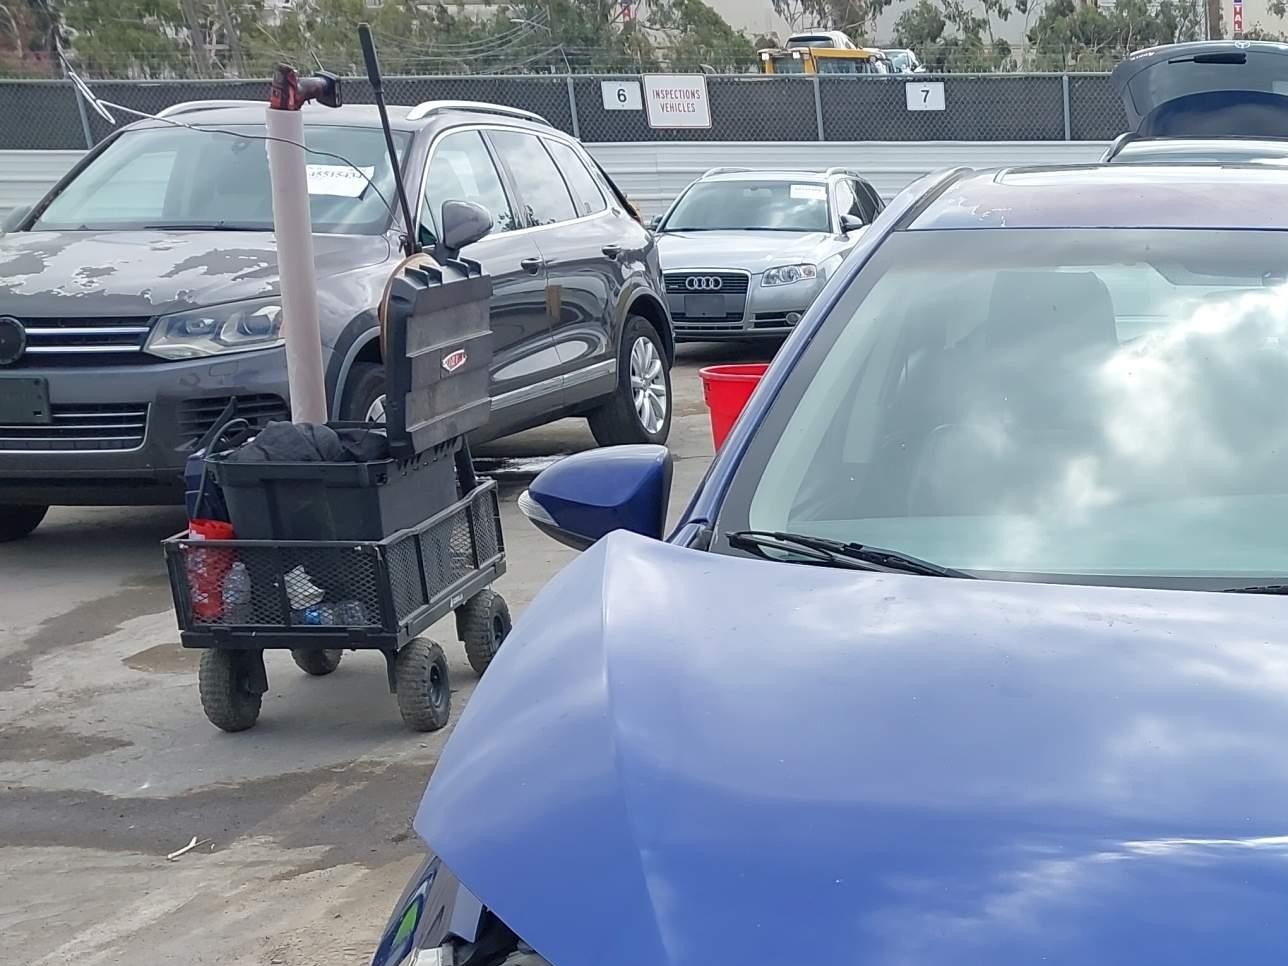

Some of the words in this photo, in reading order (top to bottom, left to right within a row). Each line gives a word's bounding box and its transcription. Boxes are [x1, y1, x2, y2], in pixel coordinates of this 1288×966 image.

[616, 88, 628, 103] 6
[652, 89, 701, 100] INSPECTIONS
[920, 89, 930, 103] 7
[660, 102, 696, 113] VEHICLES
